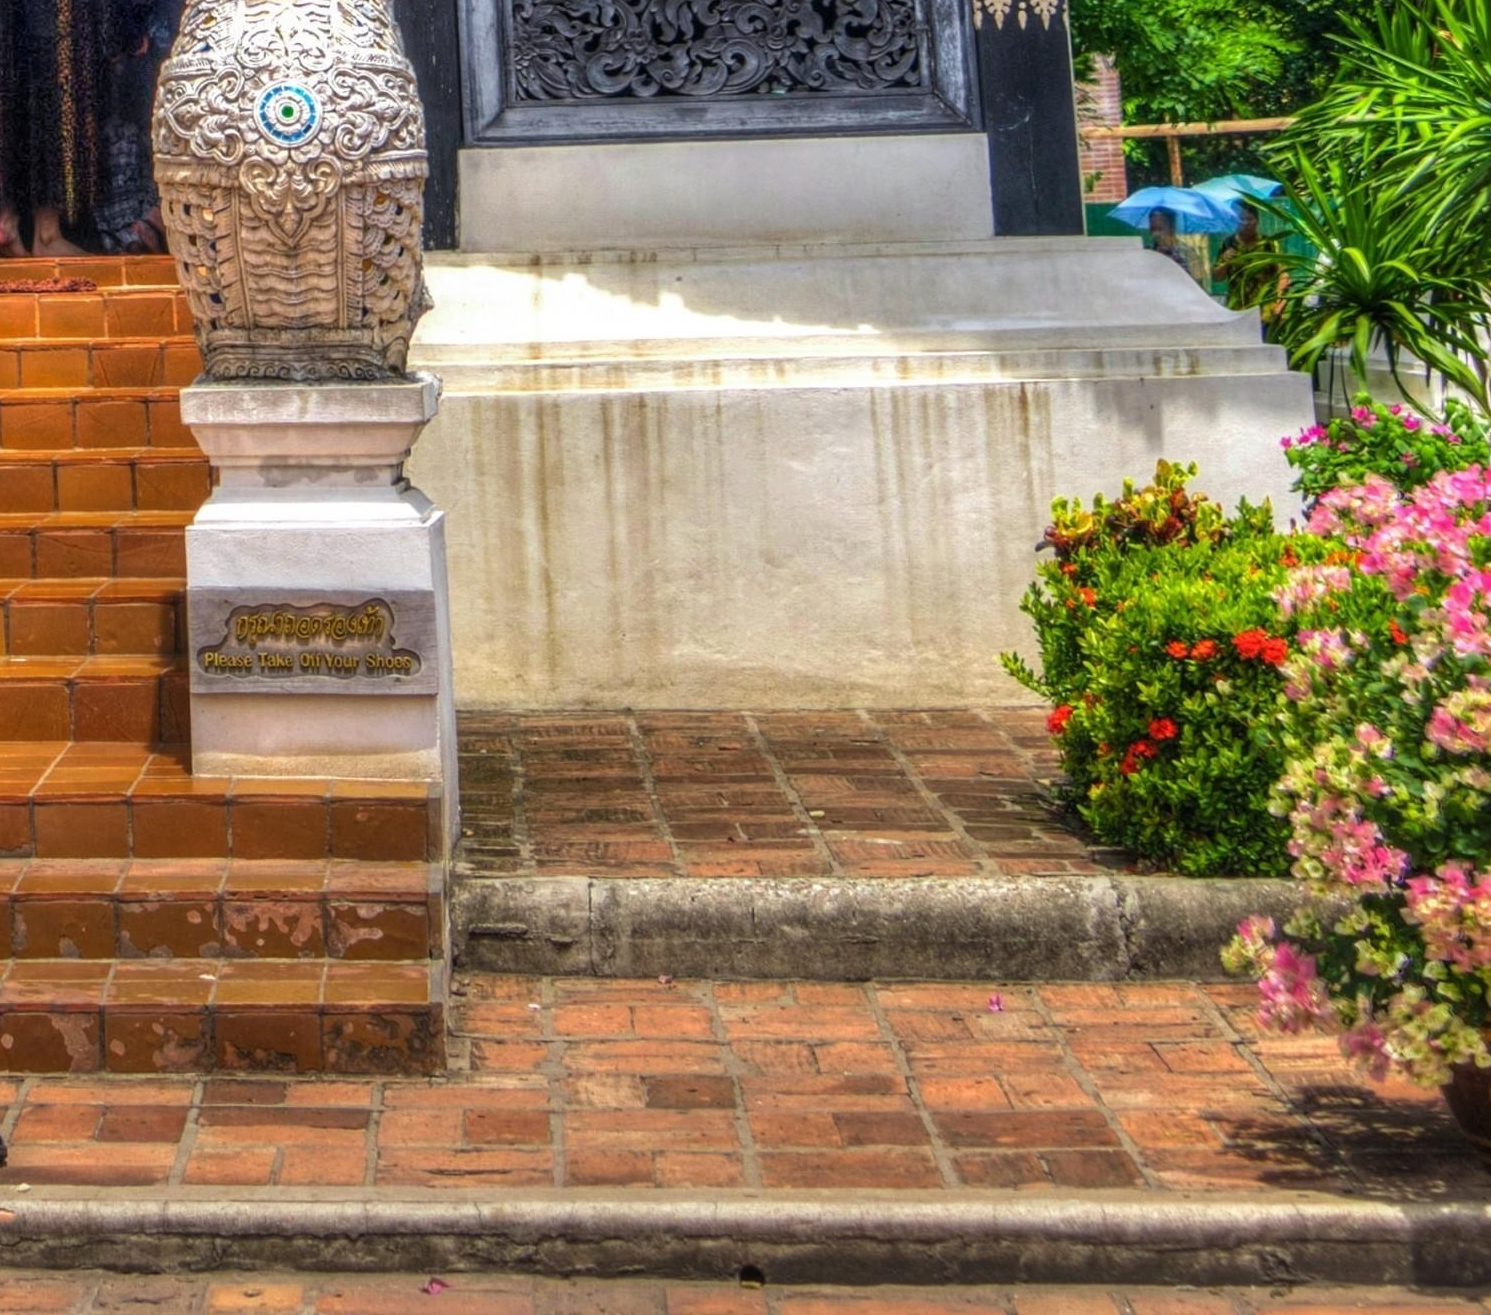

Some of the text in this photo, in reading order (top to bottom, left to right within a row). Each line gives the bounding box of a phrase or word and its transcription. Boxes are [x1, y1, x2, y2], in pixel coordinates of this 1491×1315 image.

[237, 605, 385, 646] กรุณาถอดรองเท้า
[204, 652, 412, 668] Please Take Off Your Shoes
